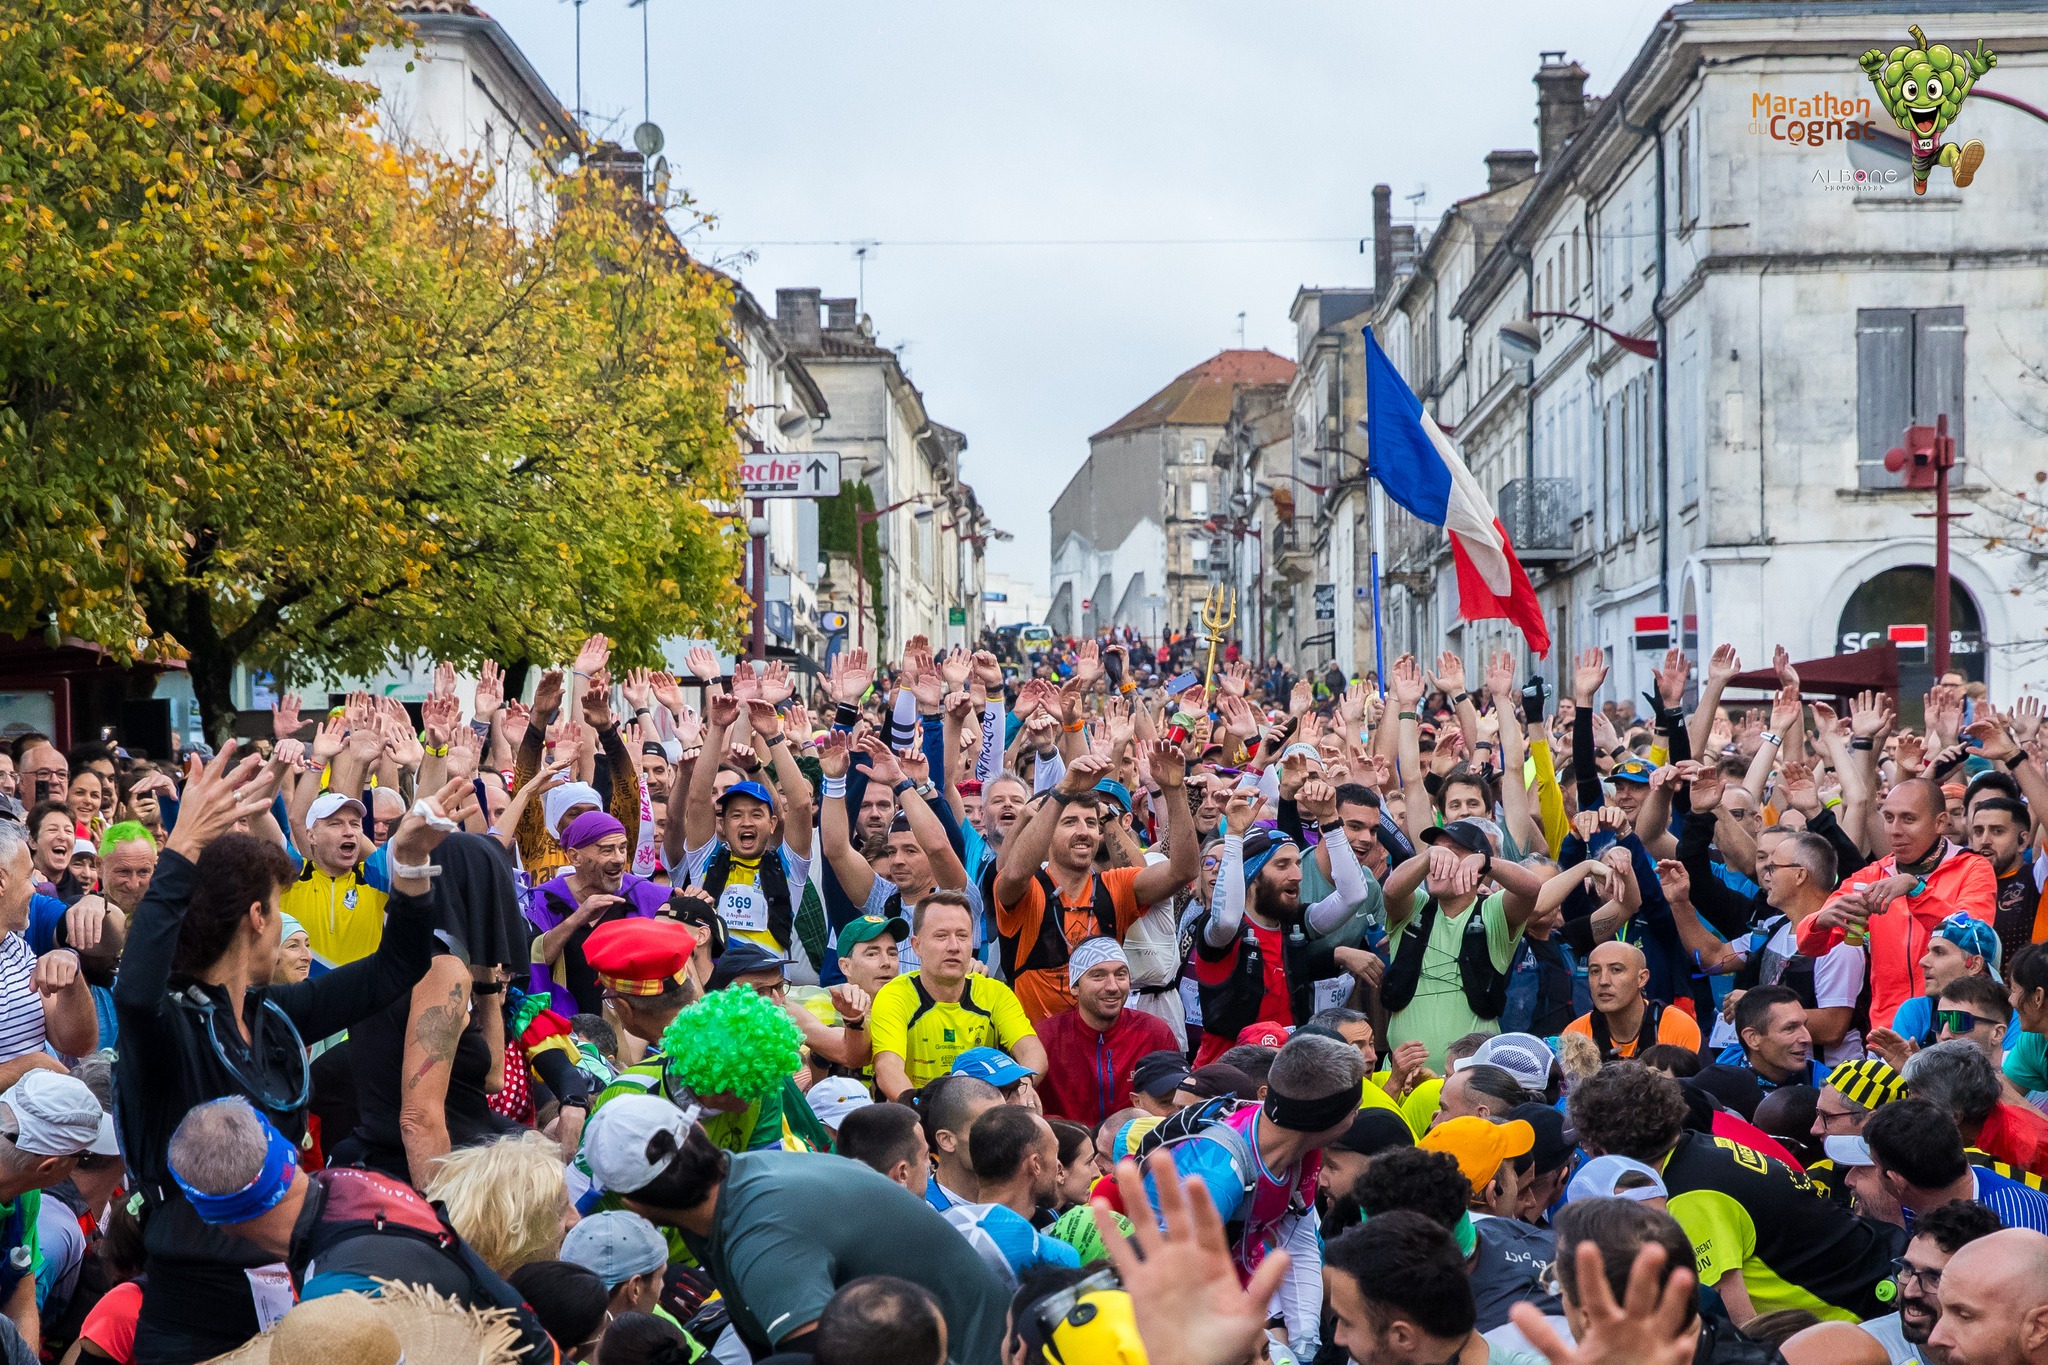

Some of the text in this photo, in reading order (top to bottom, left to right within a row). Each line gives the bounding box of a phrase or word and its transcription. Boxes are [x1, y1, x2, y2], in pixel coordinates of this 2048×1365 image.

[727, 895, 752, 910] 369
[1330, 988, 1346, 1003] 564
[1694, 1238, 1713, 1256] RENT
